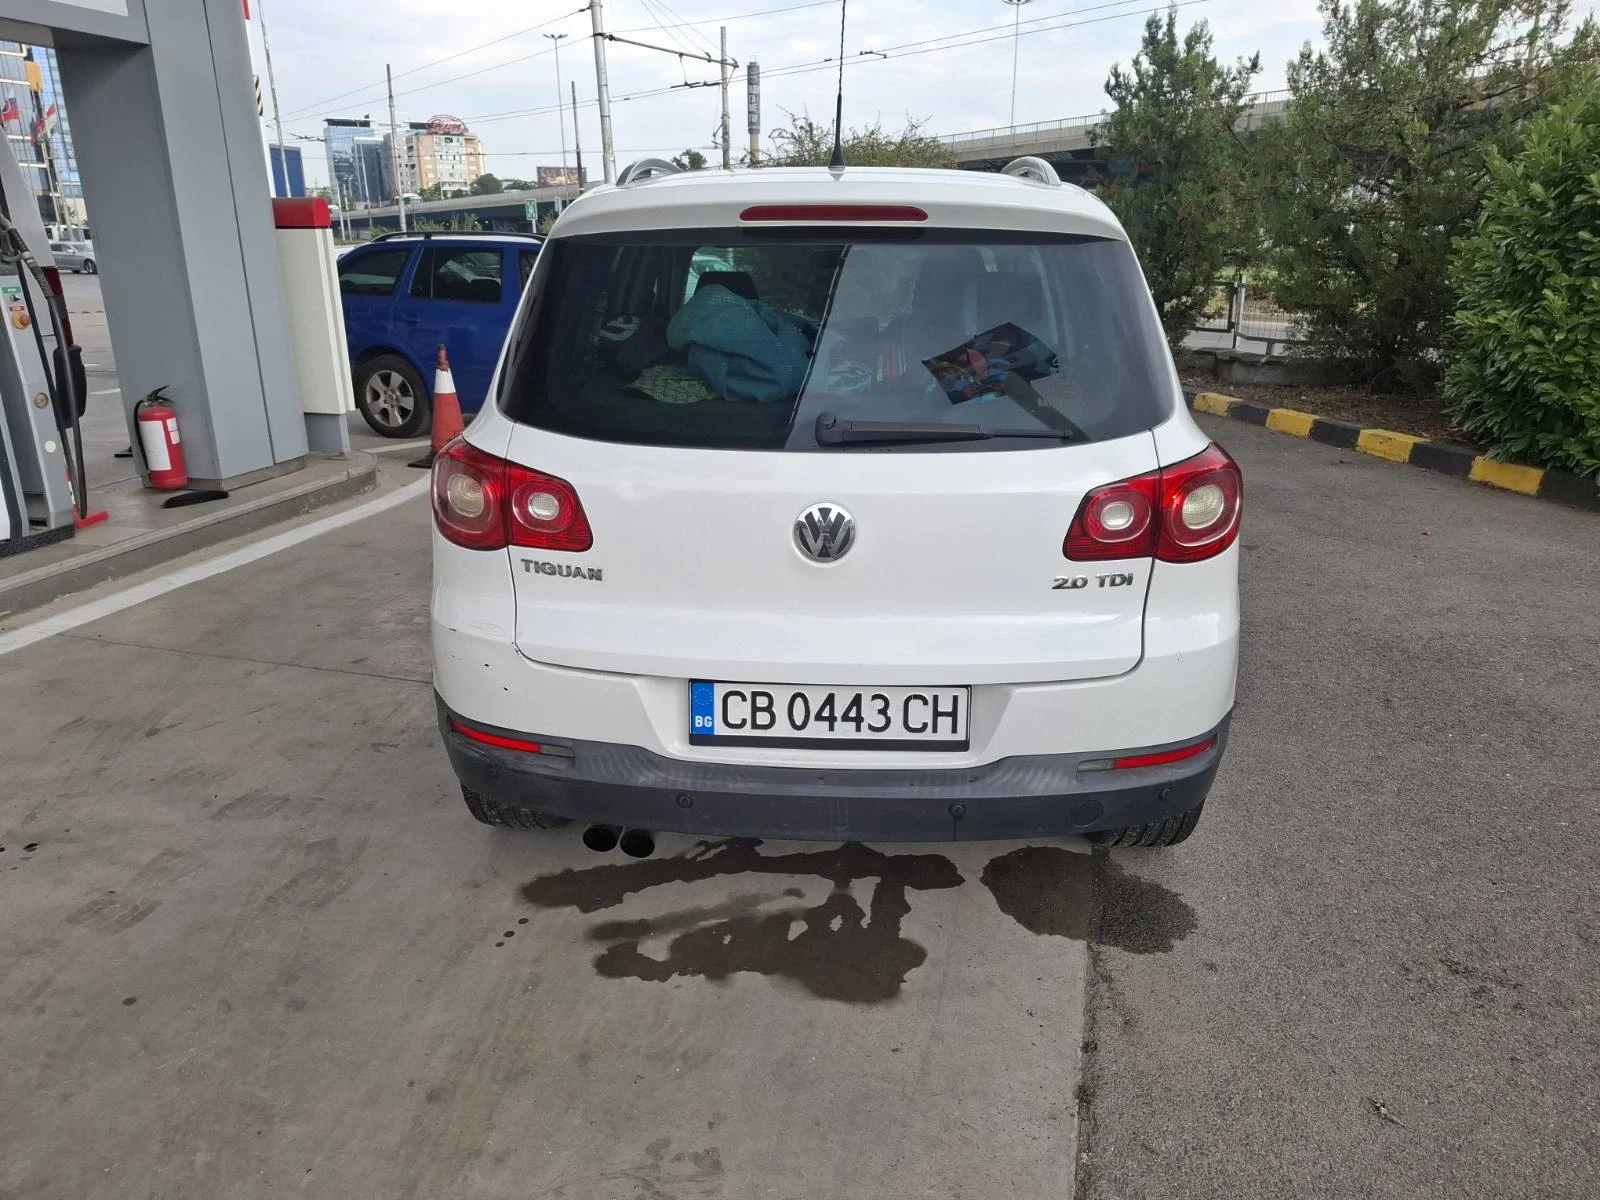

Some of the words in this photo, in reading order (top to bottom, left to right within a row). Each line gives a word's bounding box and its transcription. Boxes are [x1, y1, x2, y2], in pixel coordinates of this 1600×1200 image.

[795, 504, 854, 561] VW
[520, 558, 603, 581] TIGUAN
[694, 715, 713, 728] BG
[721, 690, 777, 730] CB
[787, 691, 892, 733] 0443
[902, 693, 959, 735] CH
